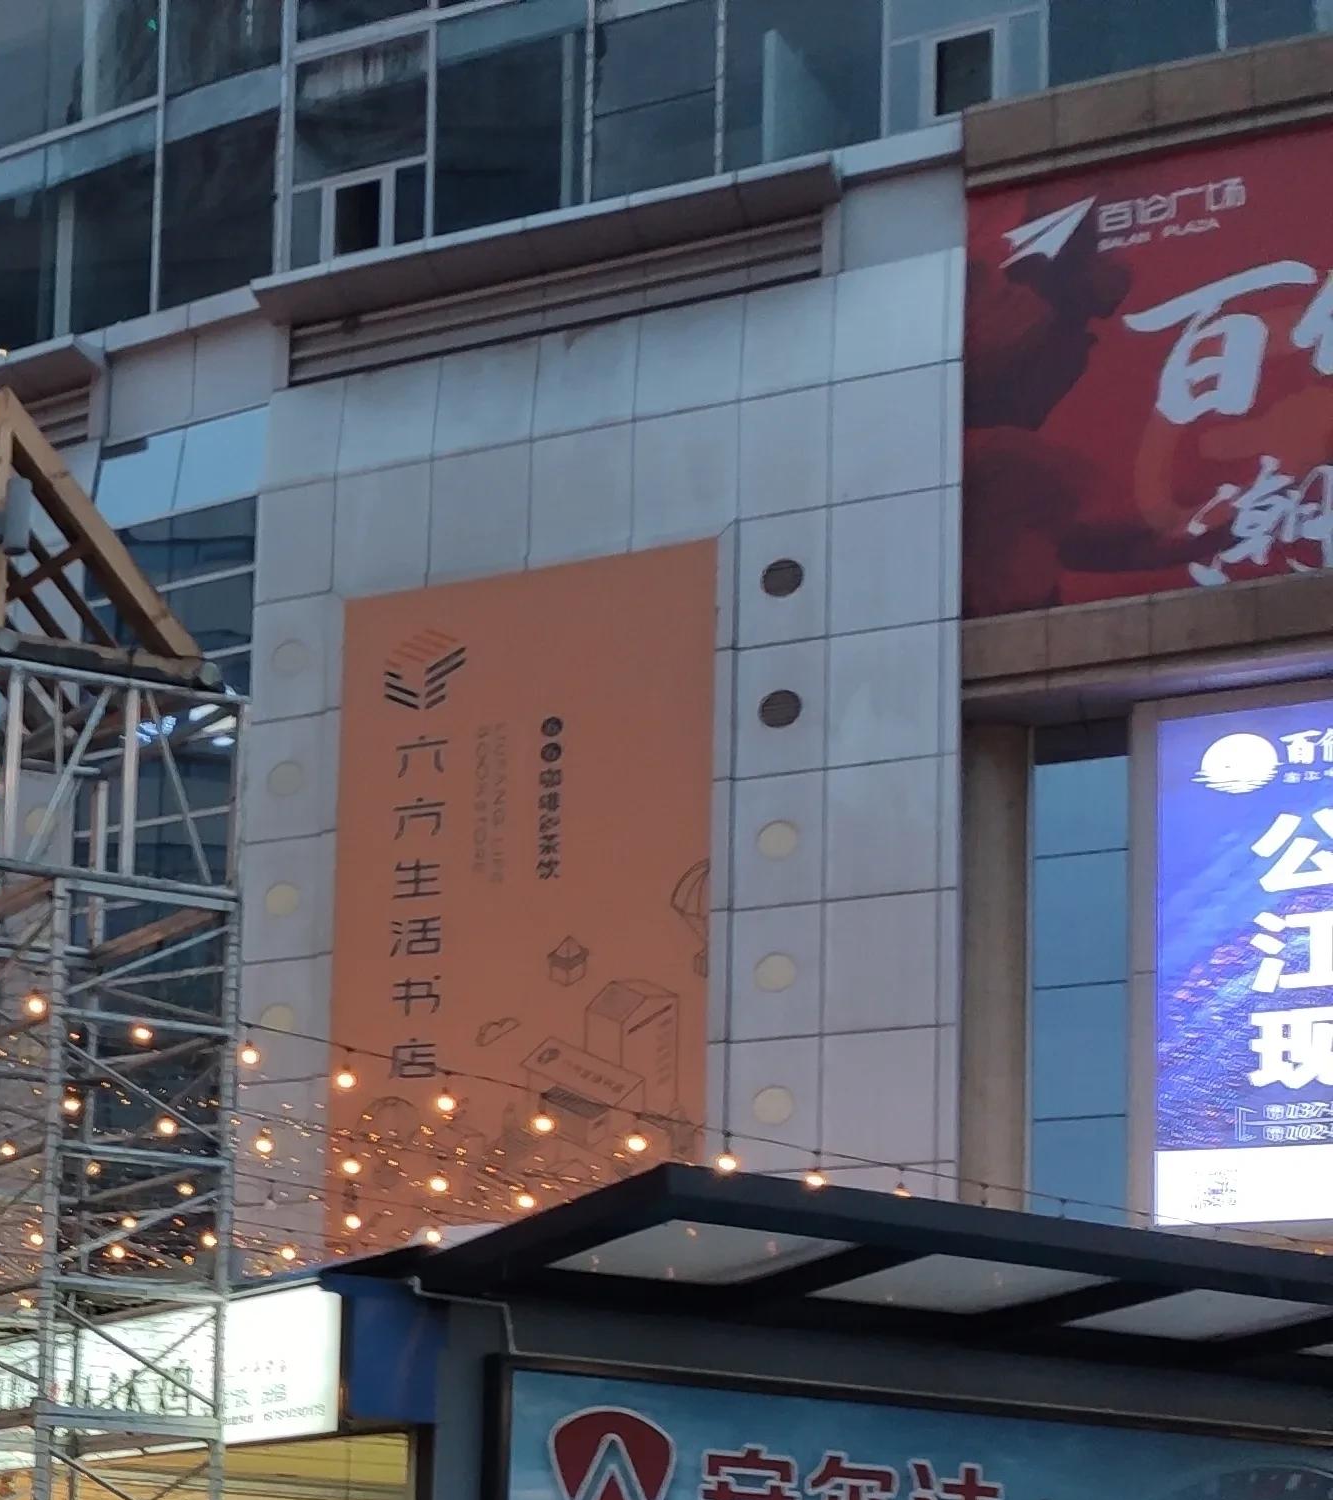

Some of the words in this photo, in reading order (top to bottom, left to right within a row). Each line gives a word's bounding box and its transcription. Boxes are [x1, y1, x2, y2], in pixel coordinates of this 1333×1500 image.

[1097, 176, 1246, 233] 百伦广场
[388, 734, 449, 1081] 六方生活书店
